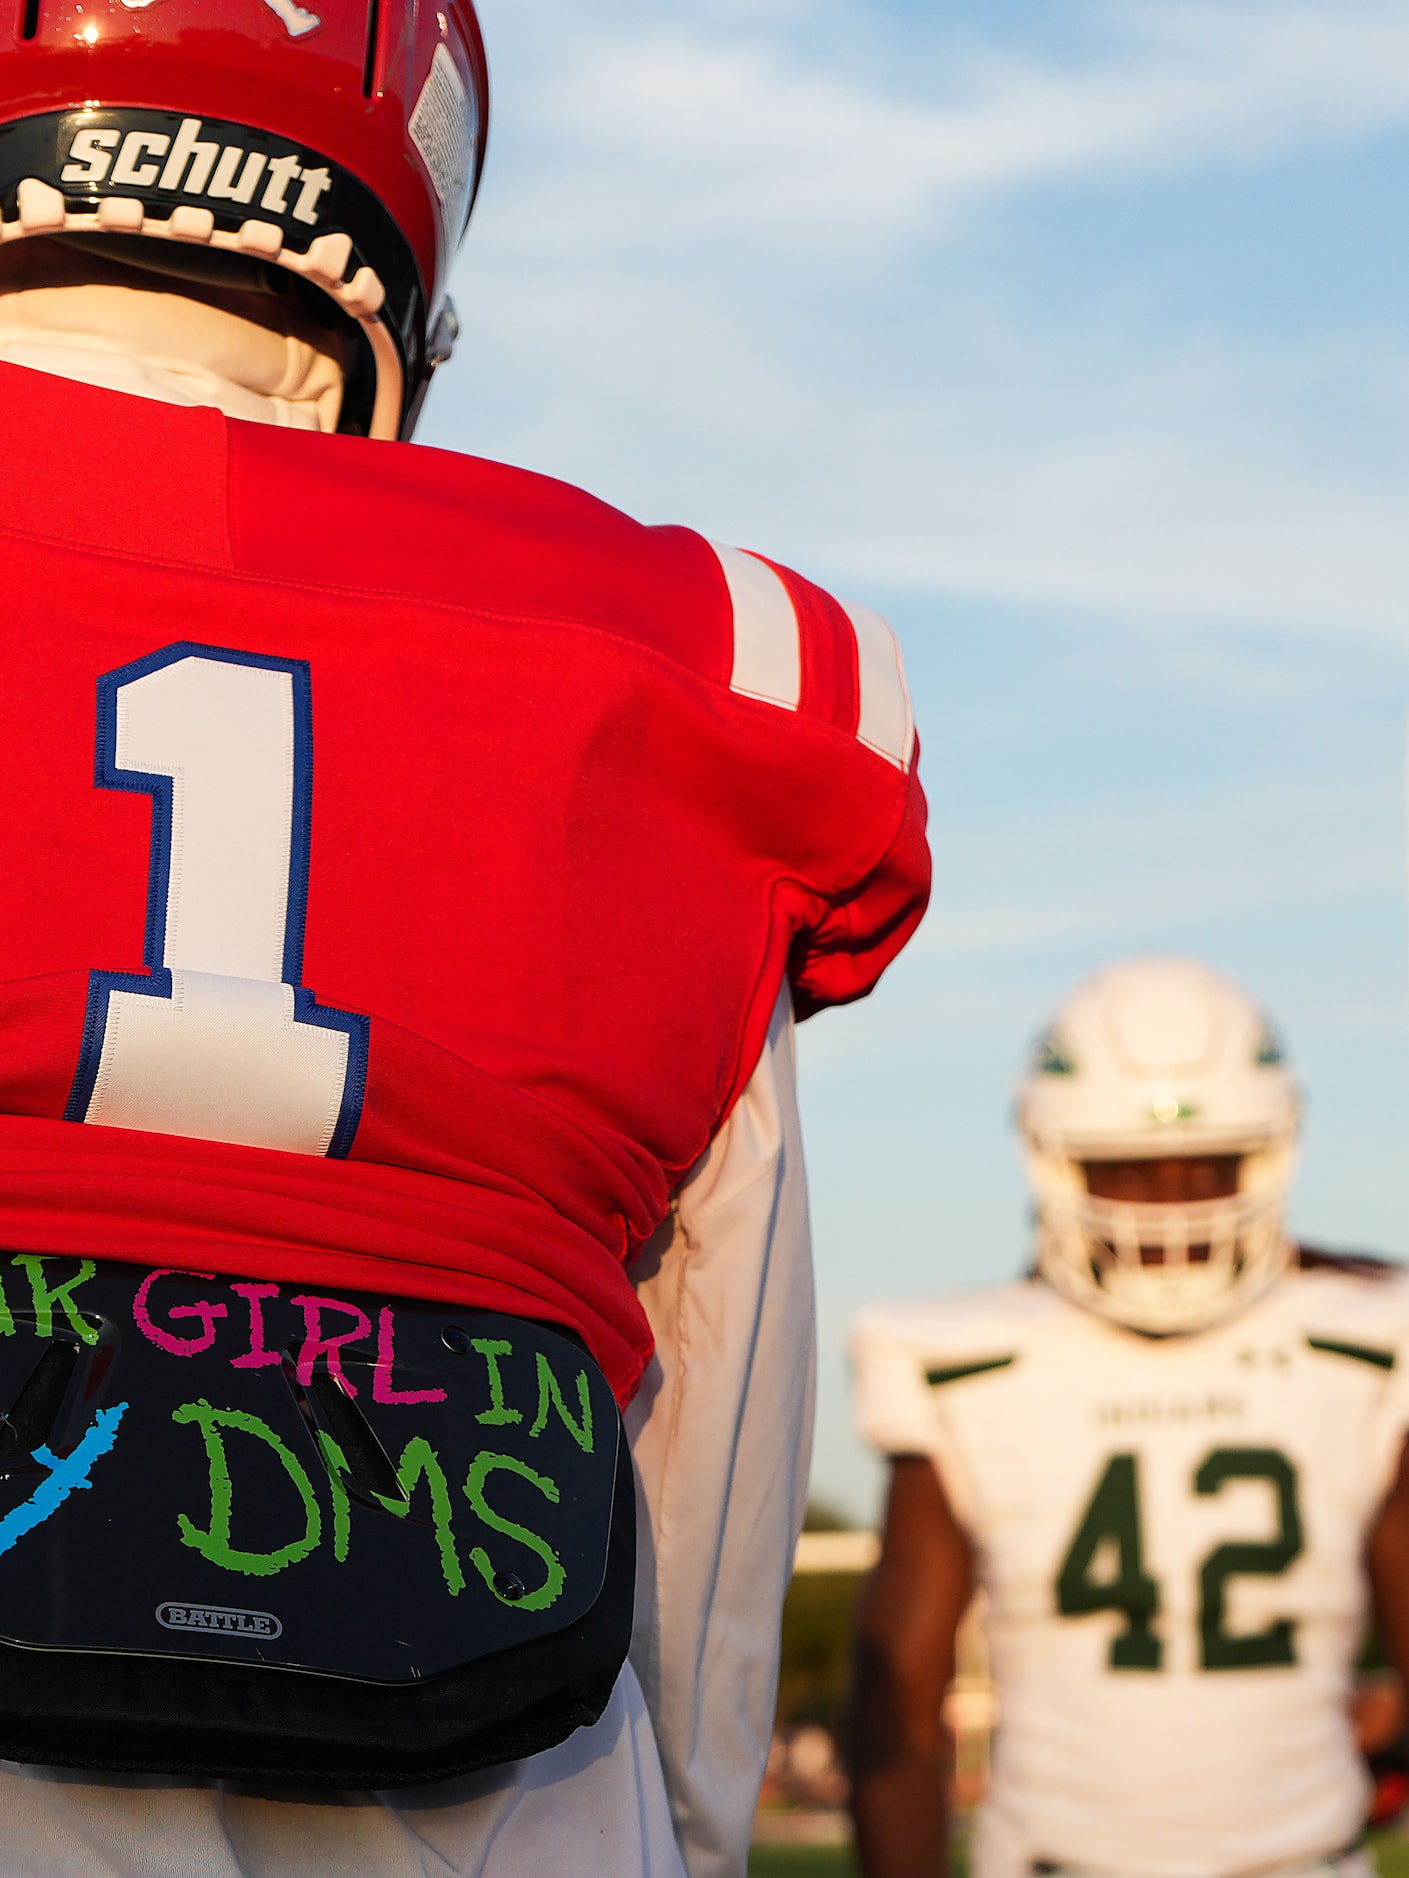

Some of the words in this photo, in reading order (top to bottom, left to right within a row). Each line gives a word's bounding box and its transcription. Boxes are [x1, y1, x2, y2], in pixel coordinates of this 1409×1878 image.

[60, 118, 332, 225] schutt
[62, 640, 369, 1160] 1
[132, 1269, 448, 1405] GIRL
[471, 1338, 594, 1454] IN
[171, 1398, 567, 1611] DMS
[1055, 1448, 1305, 1672] 42
[168, 1607, 271, 1634] BATTLE
